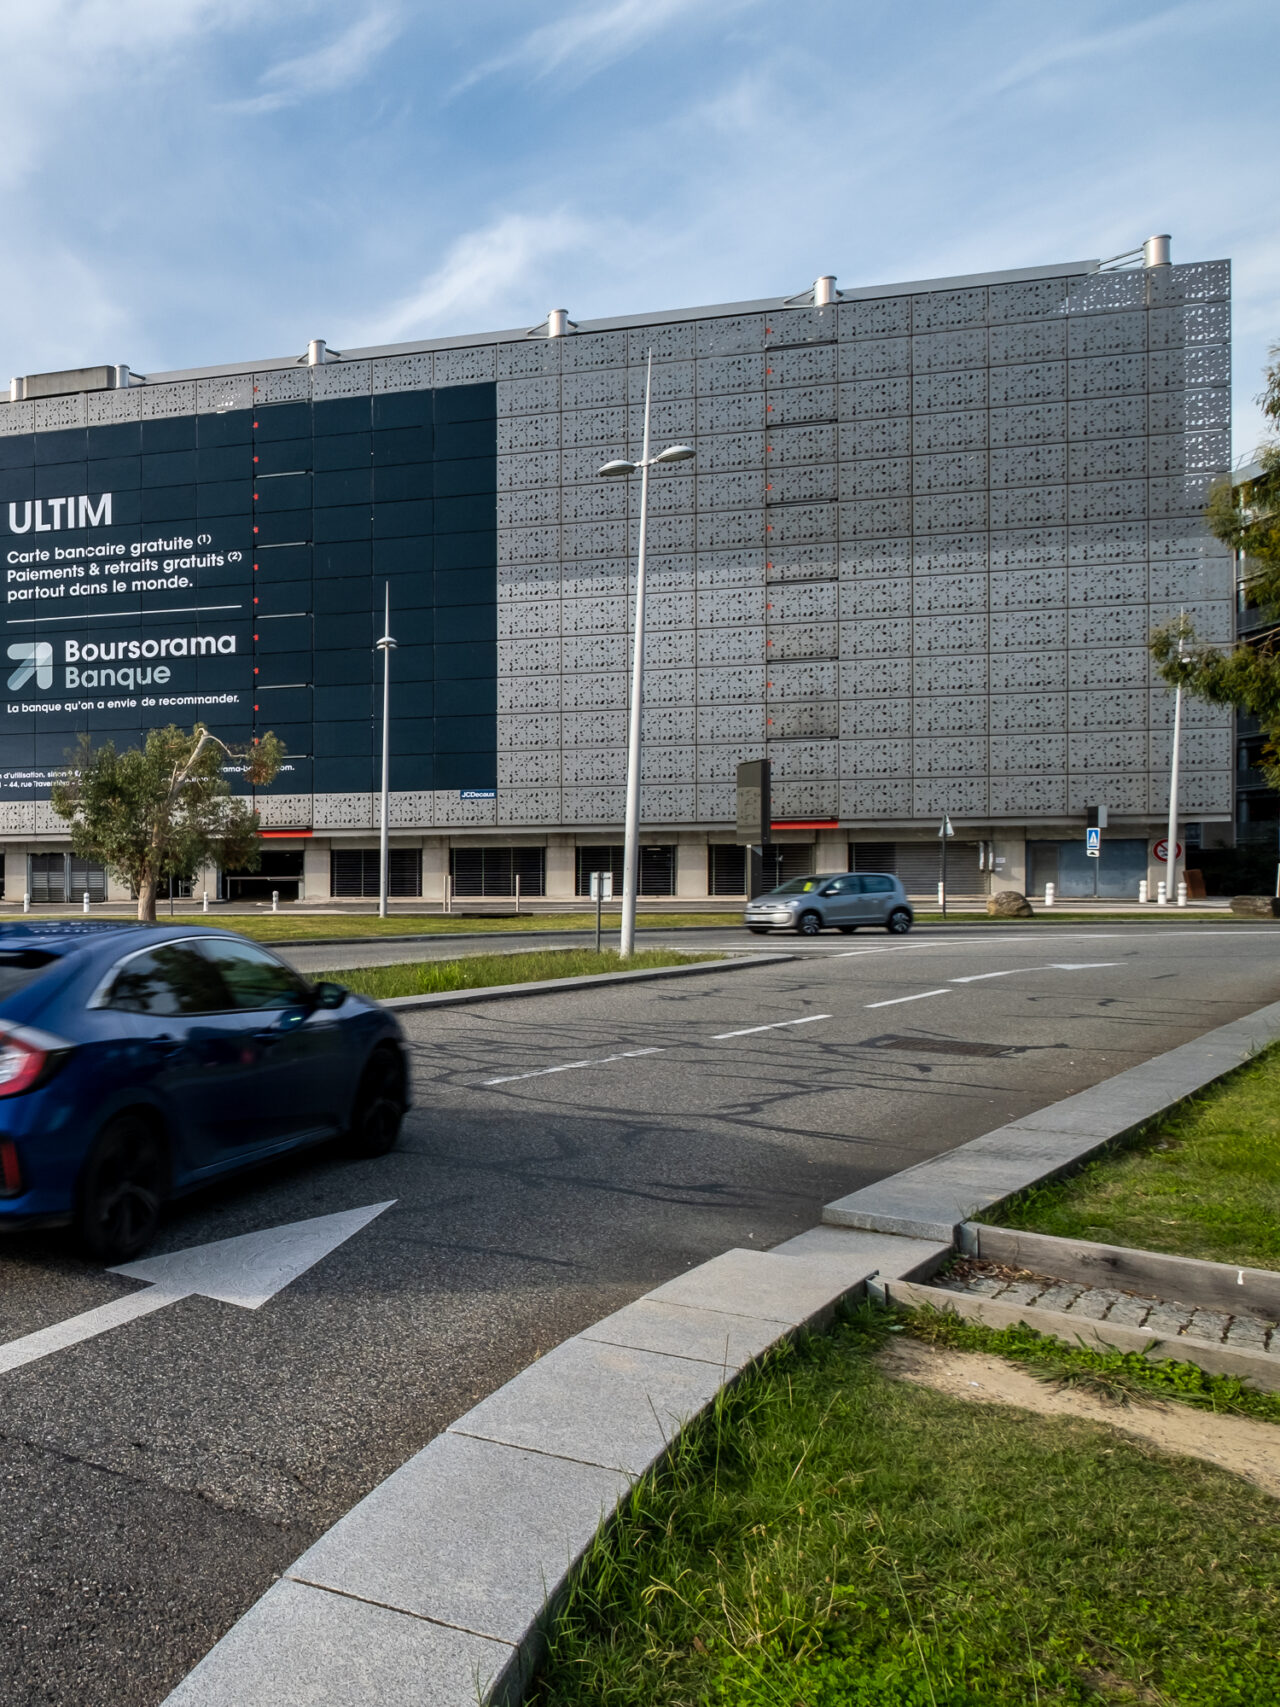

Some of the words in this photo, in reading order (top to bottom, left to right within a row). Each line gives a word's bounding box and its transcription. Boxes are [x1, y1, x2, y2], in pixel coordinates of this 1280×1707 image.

[9, 493, 111, 533] ULTIM
[7, 549, 50, 565] Carte
[54, 542, 126, 561] bancaire
[130, 536, 193, 557] gratuite
[197, 534, 212, 545] (1)
[7, 564, 85, 583] Paiements
[89, 564, 100, 575] &
[104, 557, 159, 575] retraits
[163, 553, 225, 574] gratuits
[227, 551, 242, 562] (2)
[8, 584, 65, 603] partout
[70, 583, 107, 595] dans
[113, 580, 126, 592] le
[132, 575, 193, 591] monde.
[66, 636, 235, 662] Boursorama
[66, 666, 170, 690] Banque
[8, 704, 19, 713] La
[22, 704, 61, 713] banque
[65, 701, 94, 712] qu'on
[107, 698, 136, 708] envie
[142, 697, 156, 706] de
[159, 694, 239, 705] recommander.
